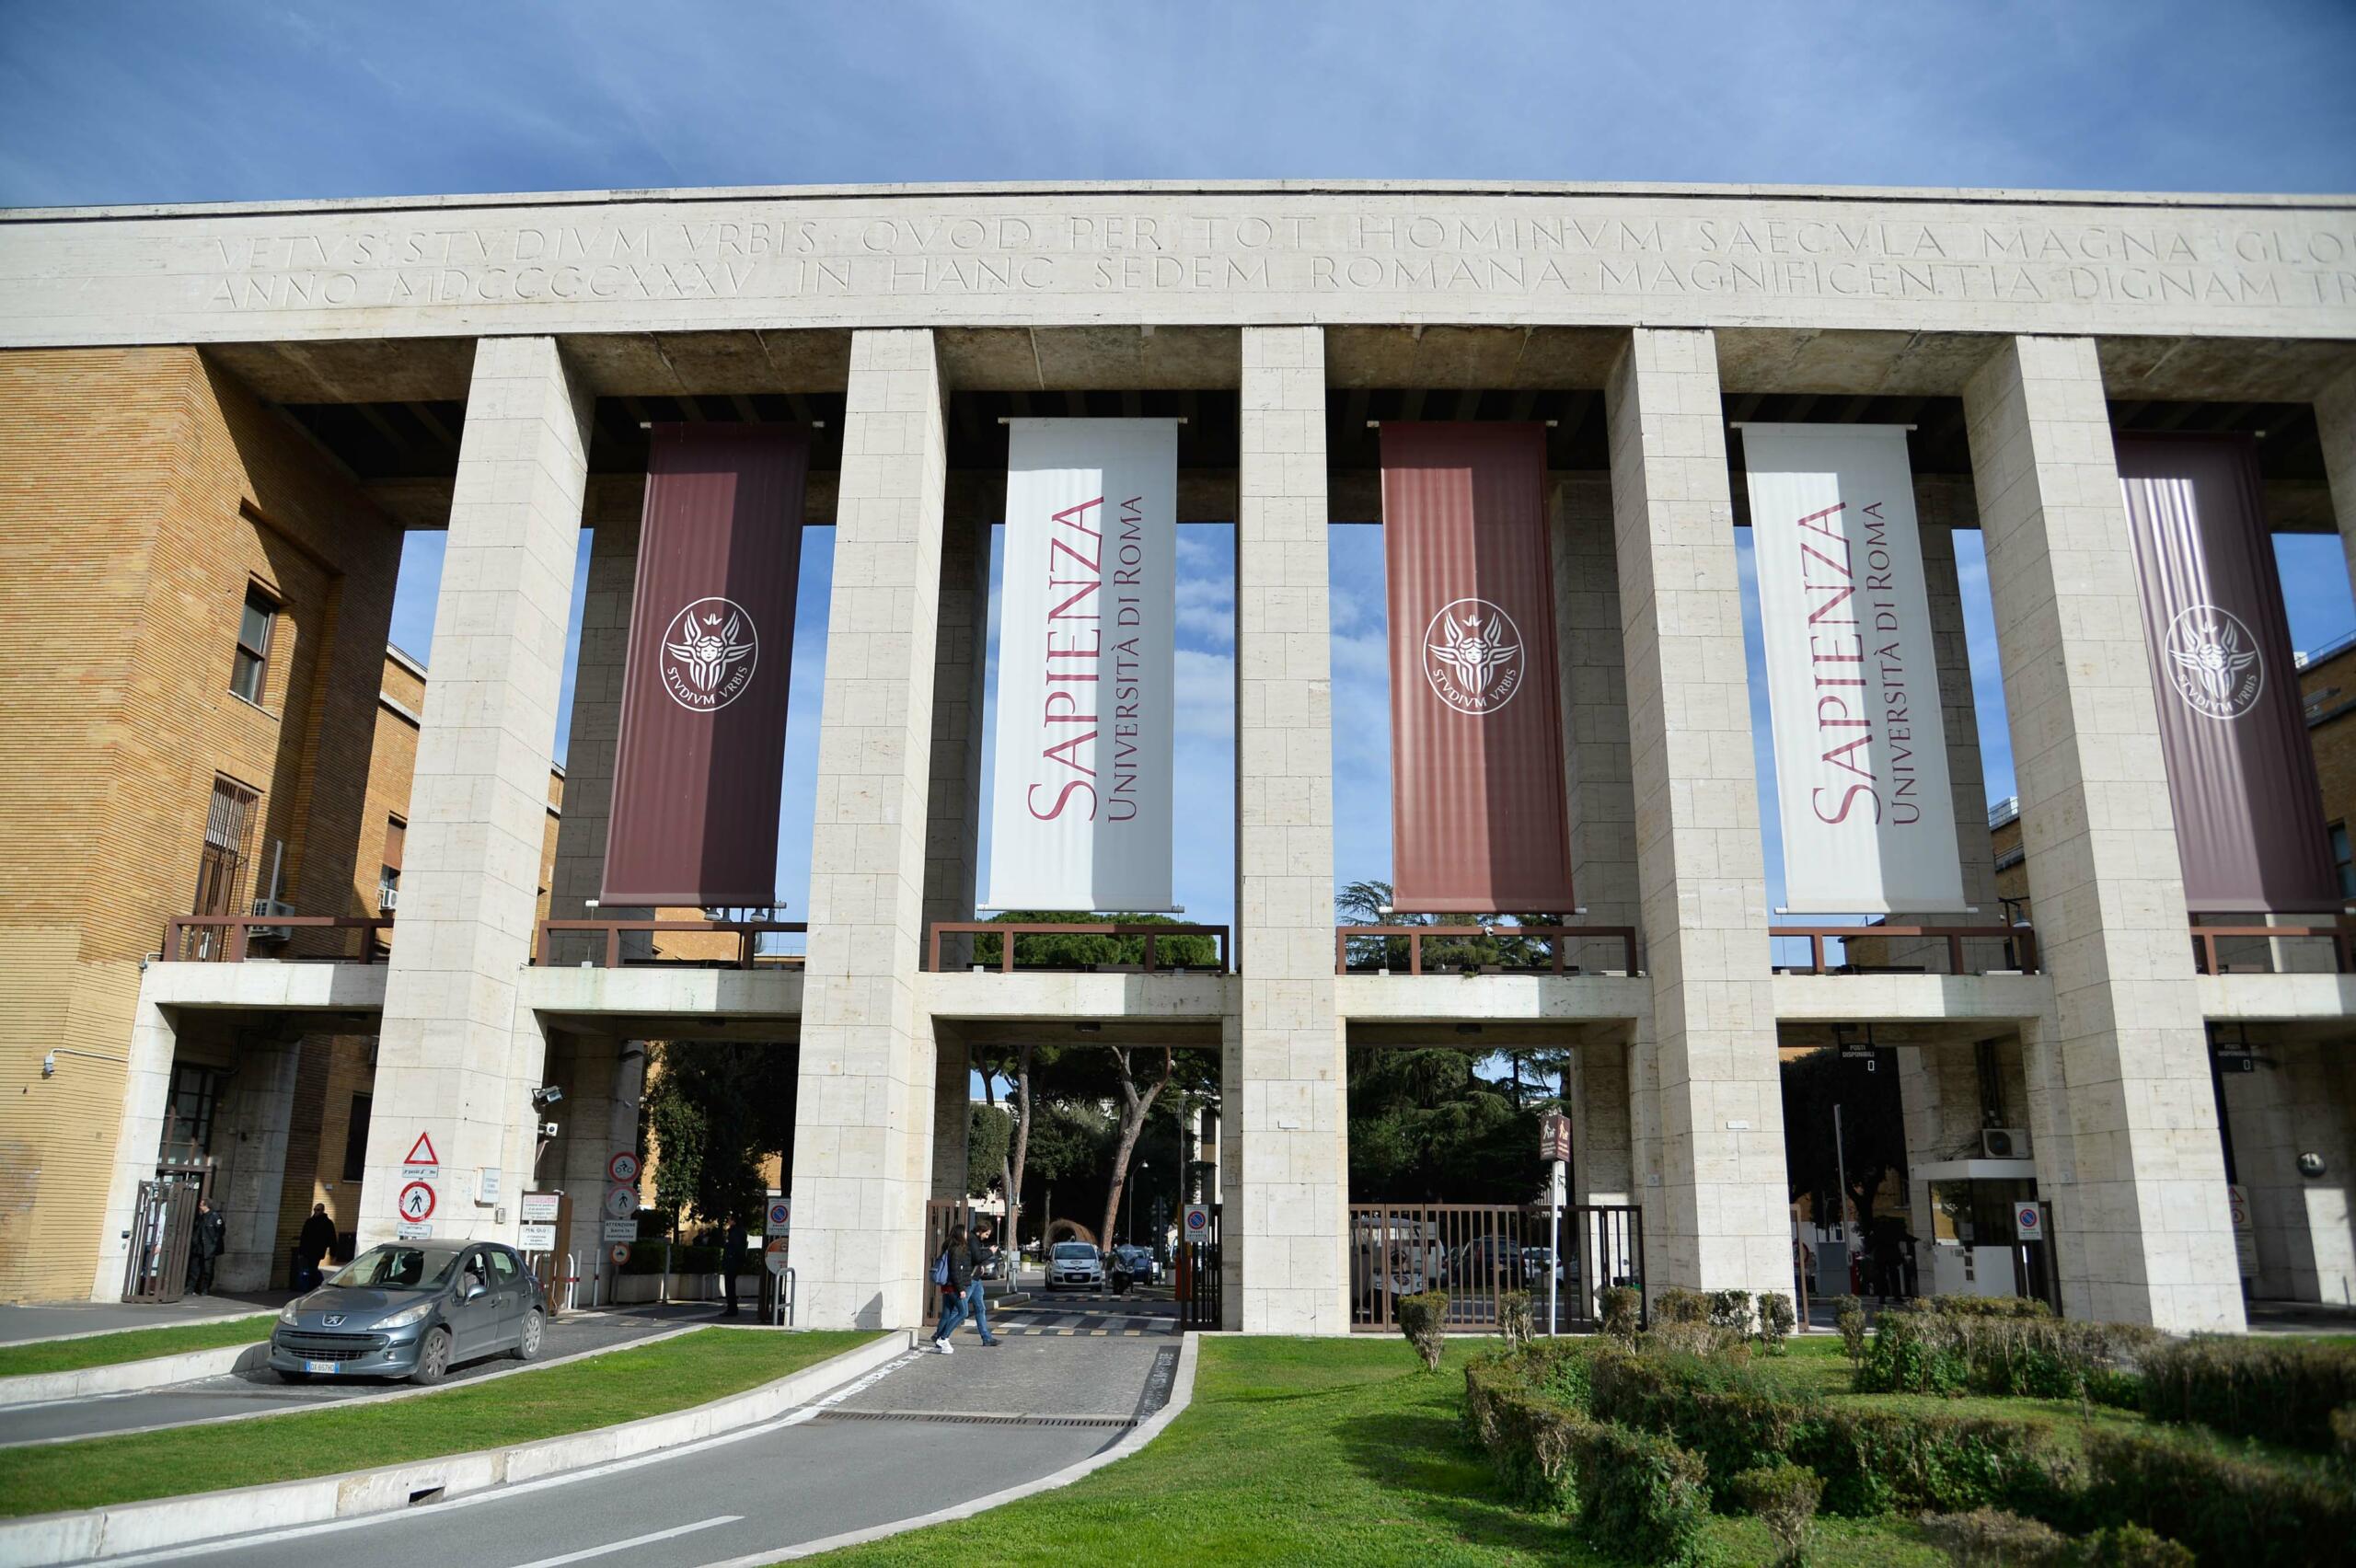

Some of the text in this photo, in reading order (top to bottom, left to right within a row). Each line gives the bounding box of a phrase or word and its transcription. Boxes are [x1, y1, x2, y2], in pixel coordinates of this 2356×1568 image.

[217, 216, 2356, 269] VETVS STVDIVM VRBIS QVOD PER TOT HOMINVM SAECVLA MAGNA GLO
[204, 272, 358, 309] ANNO
[799, 259, 851, 294] IN
[891, 257, 1054, 292] HANC
[1094, 256, 1269, 288] SEDEM
[1311, 256, 1570, 291] ROMANA
[1599, 259, 2043, 299] MAGNIFICENTIA
[2069, 265, 2281, 304] DIGNAM
[667, 665, 747, 705] STVDIVM VRBIS
[1027, 496, 1104, 822] SAPIENZA
[1108, 496, 1142, 823] UNIVERSITÀ DI ROMA
[1797, 502, 1881, 825] SAPIENZA
[1862, 502, 1920, 826] UNIVERSITÀ DI ROMA
[1433, 668, 1517, 708] STVDIVM VRBIS
[2177, 674, 2258, 712] STVDIVM VRBIS
[1867, 1060, 1875, 1071] 0
